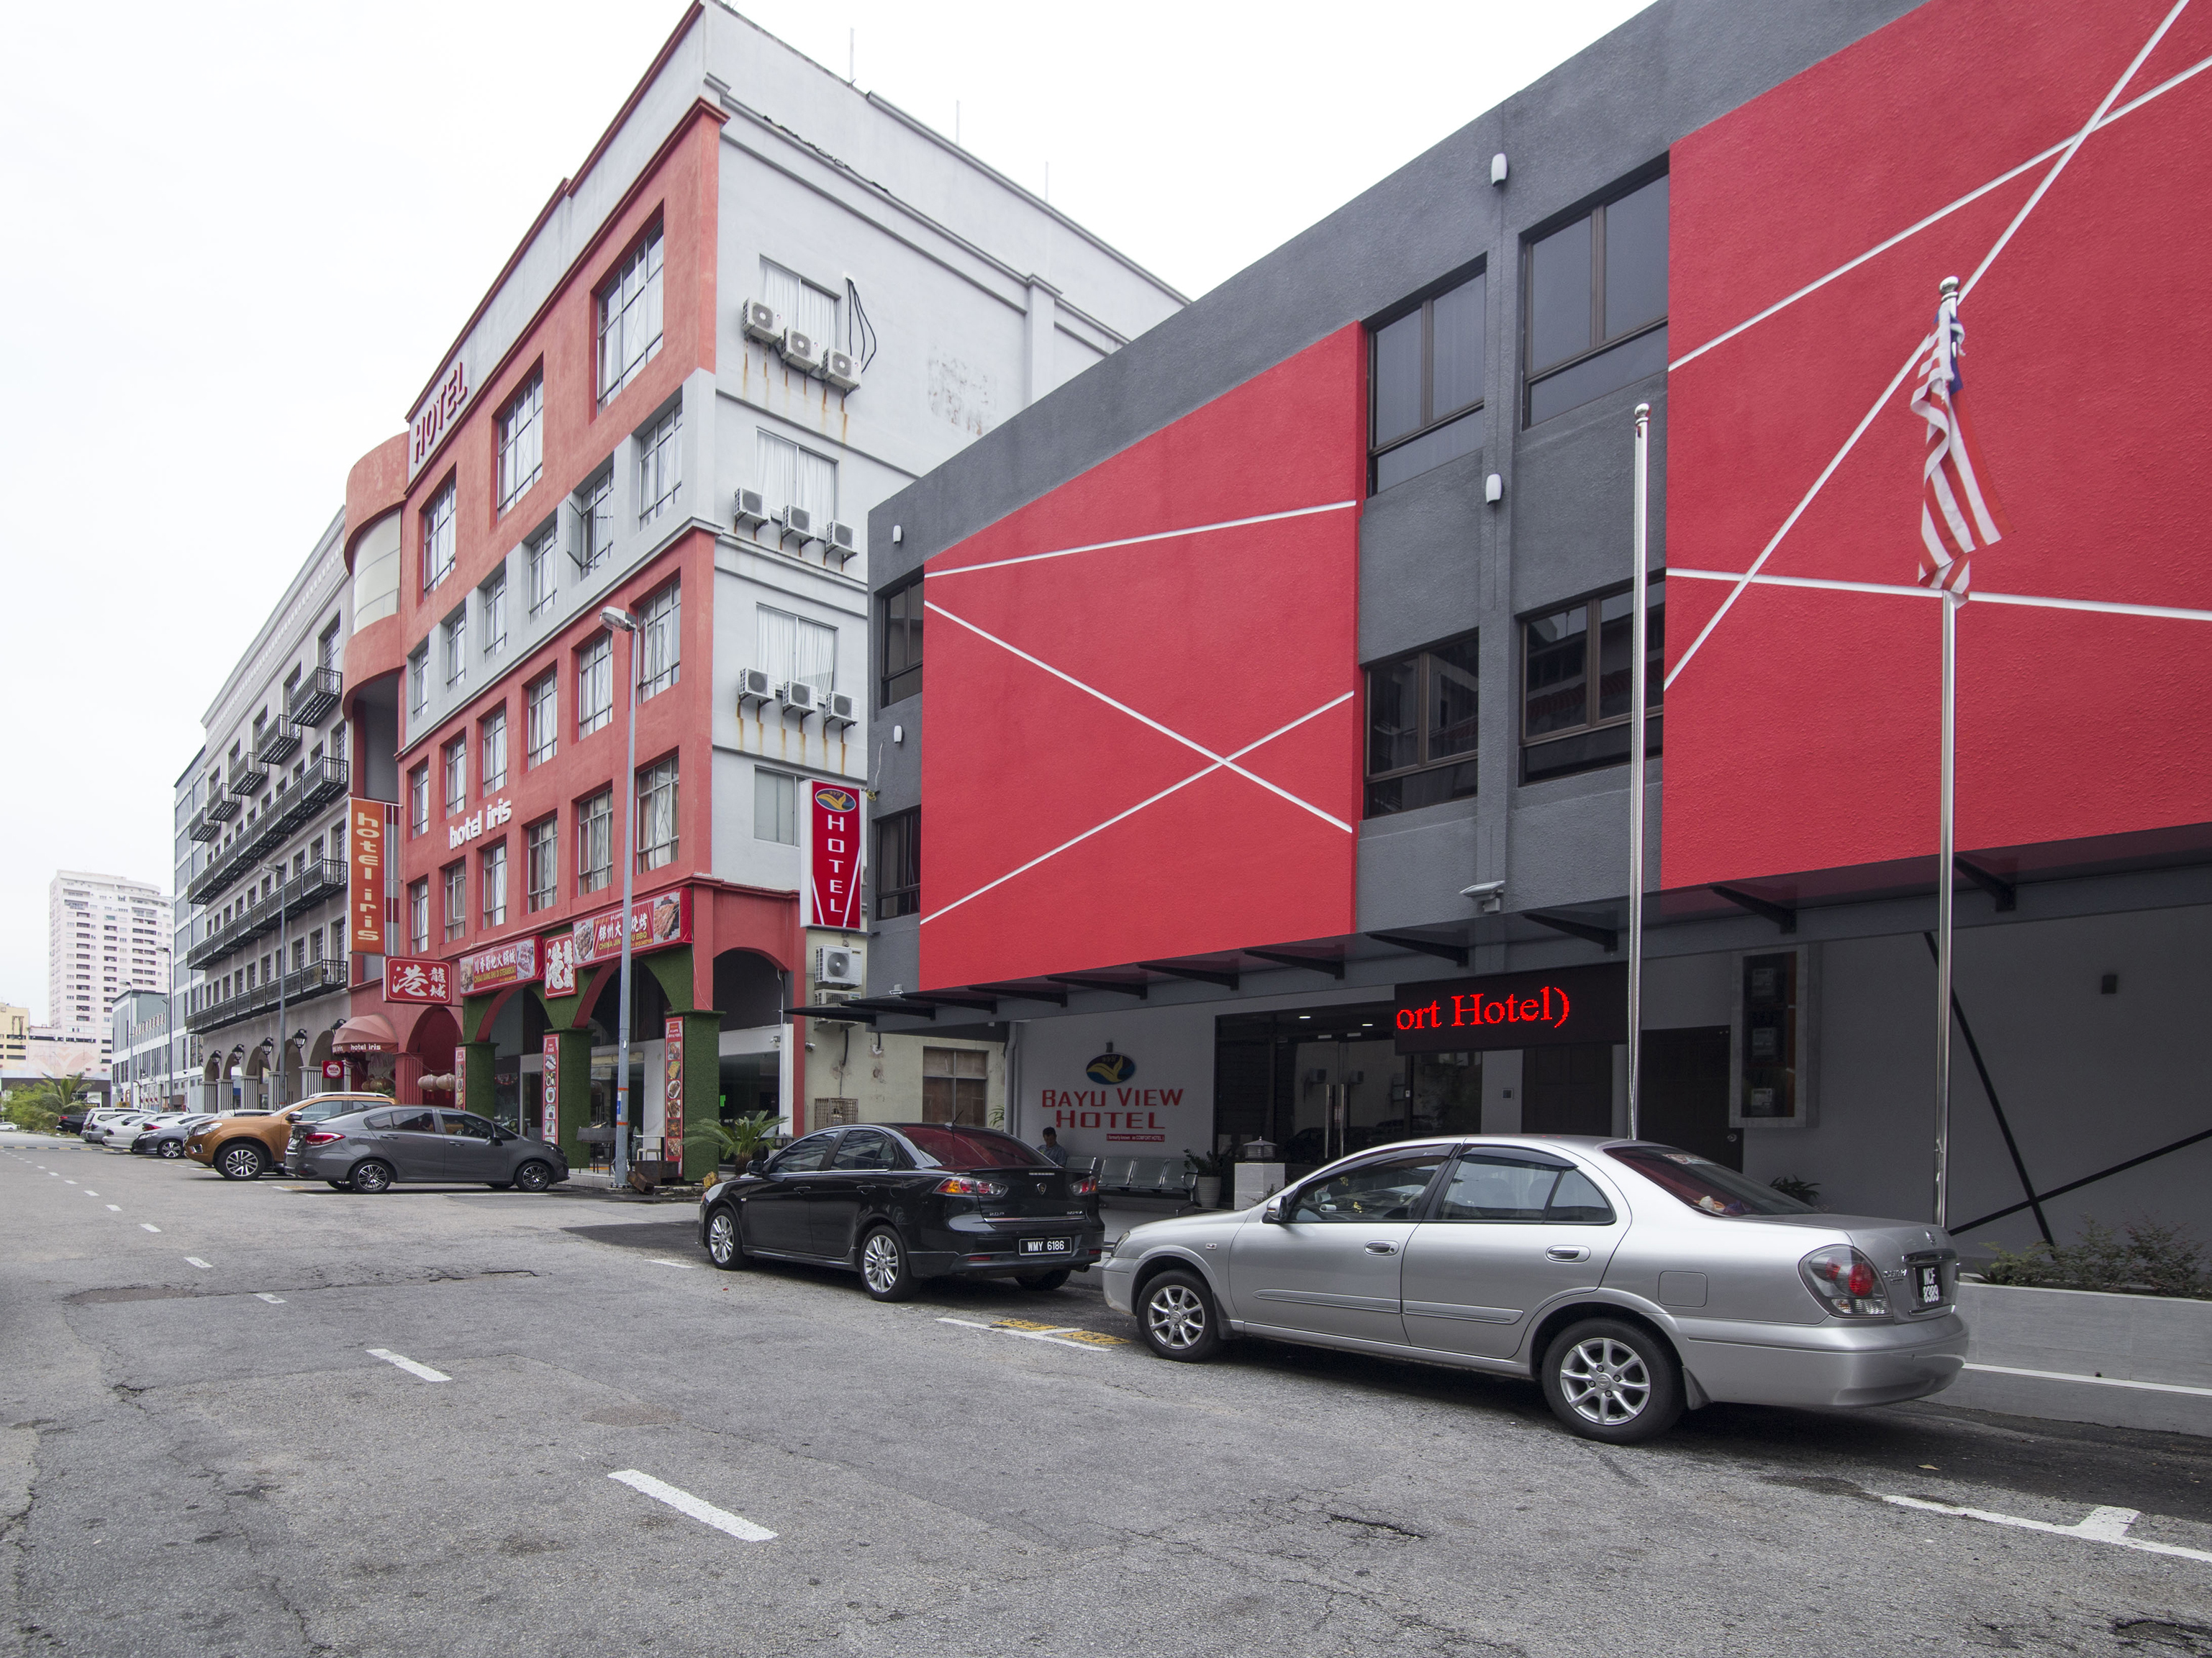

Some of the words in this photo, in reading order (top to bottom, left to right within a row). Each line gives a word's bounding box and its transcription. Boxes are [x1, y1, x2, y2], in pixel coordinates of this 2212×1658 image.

[414, 361, 468, 464] HOTEL
[450, 810, 482, 851] hotel
[486, 797, 512, 831] iris
[356, 812, 380, 880] hotel
[828, 814, 845, 912] HOTEL
[358, 888, 379, 941] iris
[599, 941, 613, 950] CHINA
[1451, 986, 1570, 1028] Hotel)
[1042, 1090, 1106, 1107] BAYU
[1117, 1087, 1184, 1107] VIEW
[1056, 1110, 1166, 1129] HOTEL
[1028, 1241, 1043, 1251] WMY
[1047, 1240, 1064, 1251] 6186
[1923, 1267, 1936, 1285] NCF
[1923, 1285, 1939, 1303] 8389
